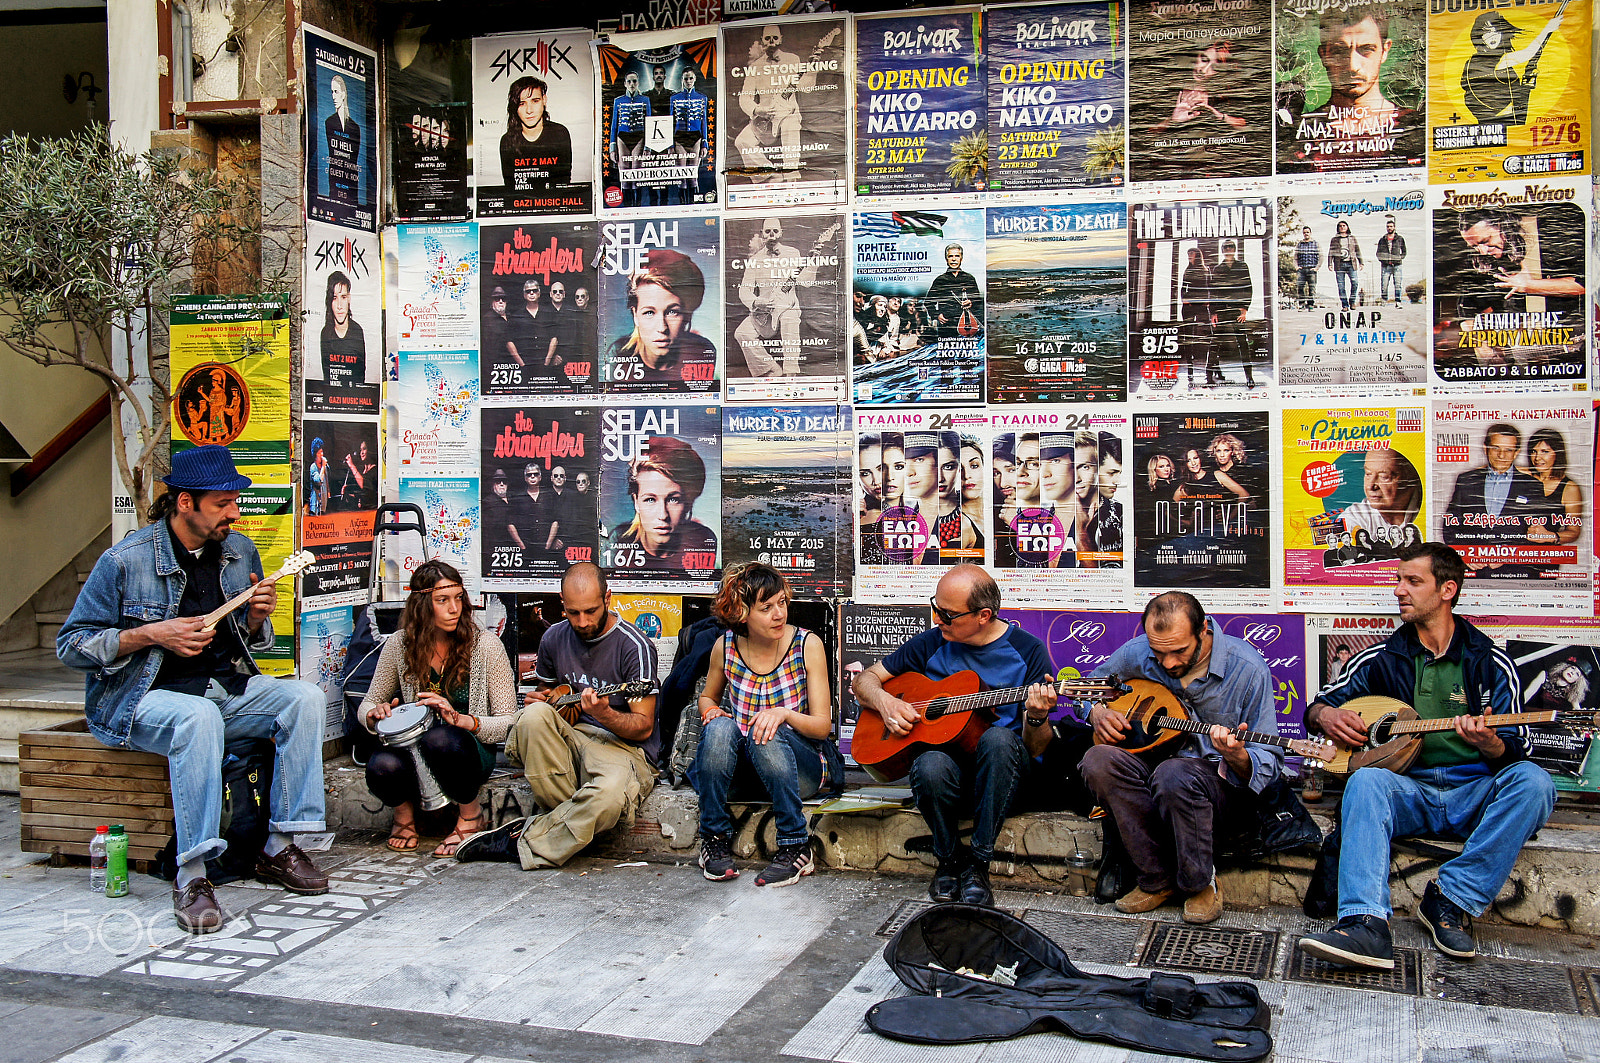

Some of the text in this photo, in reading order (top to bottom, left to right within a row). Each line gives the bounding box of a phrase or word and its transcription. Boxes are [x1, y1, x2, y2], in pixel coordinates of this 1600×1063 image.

[1139, 24, 1261, 43] Μαρία Παπαγεωργίου
[1017, 38, 1089, 49] BEACH BAR
[884, 49, 922, 57] BEACH
[315, 47, 366, 75] SATURDAY 9/5
[731, 61, 838, 78] C.W. STONEKING
[999, 58, 1105, 85] OPENING
[771, 74, 799, 86] LIVE
[867, 66, 969, 91] OPENING
[869, 92, 923, 114] KIKO
[1001, 85, 1057, 107] KIKO
[998, 104, 1113, 128] NAVARRO
[1328, 105, 1371, 121] ΔΗΜΟΣ
[867, 110, 977, 134] NAVARRO
[1295, 113, 1404, 140] ΑΝΑΣΤΑΣΙΑΔΗΣ
[1000, 130, 1062, 143] SATURDAY
[1435, 124, 1503, 139] SISTERS OF YOUR
[1529, 122, 1581, 147] 12/6
[339, 140, 353, 153] HELL
[868, 136, 927, 150] SATURDAY
[1155, 139, 1167, 147] από
[1304, 136, 1396, 156] 9-16-23 ΜΑΪΟΥ
[1435, 136, 1476, 149] SUNSHINE
[742, 146, 790, 155] ΠΑΡΑΣΚΕΥΗ
[866, 149, 887, 164] 23
[998, 145, 1019, 160] 23
[514, 156, 558, 167] SAT 2 MAY
[1567, 159, 1581, 170] 205
[514, 171, 549, 179] POSTRIPER
[622, 168, 695, 180] KADEBOSTANY
[867, 167, 887, 175] AFTER
[513, 199, 532, 207] GAZI
[534, 198, 560, 207] MUSIC
[562, 197, 584, 206] HALL
[993, 212, 1119, 233] MURDER BY DEATH
[1134, 205, 1267, 240] THE LIMINANAS
[513, 226, 533, 249] the
[602, 220, 679, 249] SELAH
[857, 242, 897, 253] ΚΡΗΤΕΣ
[602, 247, 649, 276] SUE
[731, 255, 838, 270] C.W. STONEKING
[857, 251, 928, 262] ΠΑΛΑΙΣΤΙΝΙΟΙ
[770, 268, 800, 279] LIVE
[742, 339, 790, 348] ΠΑΡΑΣΚΕΥΗ
[937, 341, 979, 350] ΒΑΣΙΛΗΣ
[1142, 335, 1179, 354] 8/5
[1299, 333, 1349, 345] 7 & 14
[936, 349, 980, 358] ΣΚΟΥΛΑΣ
[1015, 341, 1097, 355] 16 MAY 2015
[1327, 347, 1378, 355] special guests:
[329, 354, 340, 362] SAT
[341, 355, 345, 363] 2
[1303, 355, 1321, 364] 7/5
[1378, 353, 1402, 362] 14/5
[490, 370, 522, 385] 23/5
[602, 363, 645, 381] 16/5
[1443, 363, 1583, 378] ΣΑΒΒΑΤΟ 9 & 16 ΜΑΪΟΥ
[329, 396, 373, 405] GAZI MUSIC HALL
[1448, 402, 1474, 410] Γιώργος
[1327, 410, 1351, 418] Μίμης
[1435, 408, 1587, 421] ΜΑΡΓΑΡΙΤΗΣ ΚΩΝΣΤΑΝΤΙΝΑ
[514, 411, 534, 432] the
[602, 409, 679, 434] SELAH
[729, 414, 801, 432] MURDER BY
[859, 414, 922, 424] ΓΥΑΛΙΝΟ
[929, 414, 953, 430] 24
[992, 414, 1059, 425] ΓΥΑΛΙΝΟ
[1066, 414, 1090, 430] 24
[1184, 418, 1192, 429] 30
[1311, 419, 1393, 440] Cinema
[493, 421, 585, 470] stranglers
[602, 434, 650, 461] SUE
[1307, 475, 1322, 490] 15
[884, 521, 920, 533] ΕΔΩ
[1018, 523, 1056, 535] ΕΔΩ
[749, 537, 824, 549] 16 MAY 2015
[884, 535, 941, 549] ΤΩΡΑ
[1018, 537, 1077, 551] ΤΩΡΑ
[1468, 547, 1475, 556] 2
[1478, 545, 1517, 556] ΜΑΪΟΥ
[491, 553, 523, 568] 23/5
[602, 550, 646, 567] 16/5
[339, 562, 343, 570] 8
[318, 576, 341, 592] Σταυρός
[613, 600, 632, 614] Μια
[846, 616, 926, 625] Ο ΡΟΖΕΝΚΡΑΝΤΖ &
[1333, 618, 1396, 629] ΑΝΑΦΟΡΑ
[846, 634, 877, 645] ΕΙΝΑΙ
[1081, 645, 1090, 653] &
[1540, 733, 1564, 741] ΠΙΑΝΟΥ
